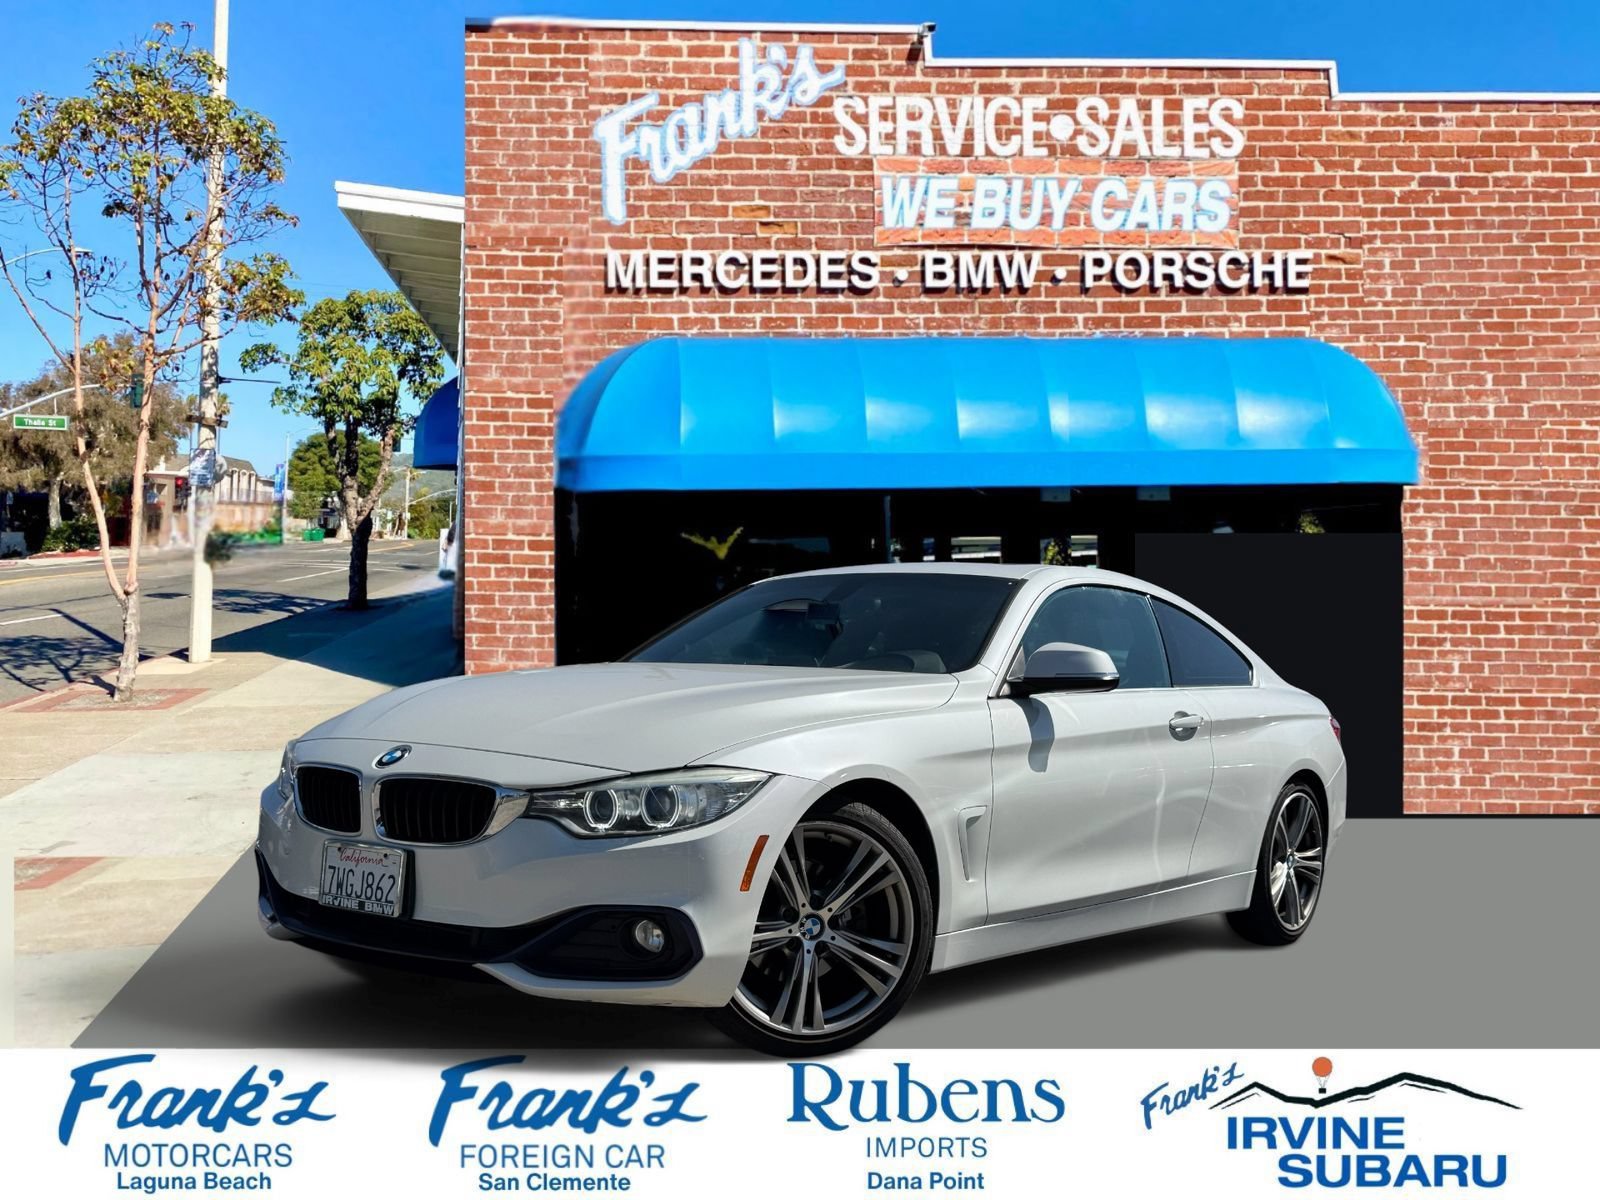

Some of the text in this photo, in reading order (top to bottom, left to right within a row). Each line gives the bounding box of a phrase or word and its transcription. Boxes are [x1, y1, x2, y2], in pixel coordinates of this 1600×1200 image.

[593, 37, 846, 225] Frank's
[833, 96, 1246, 158] SERVICE SALES
[880, 175, 1233, 233] WE BUY CARS
[605, 250, 1313, 291] MERCEDES BMW PORSCHE
[339, 847, 388, 867] California
[323, 894, 395, 915] IRVINE BMW
[328, 865, 396, 903] 7WGJ862
